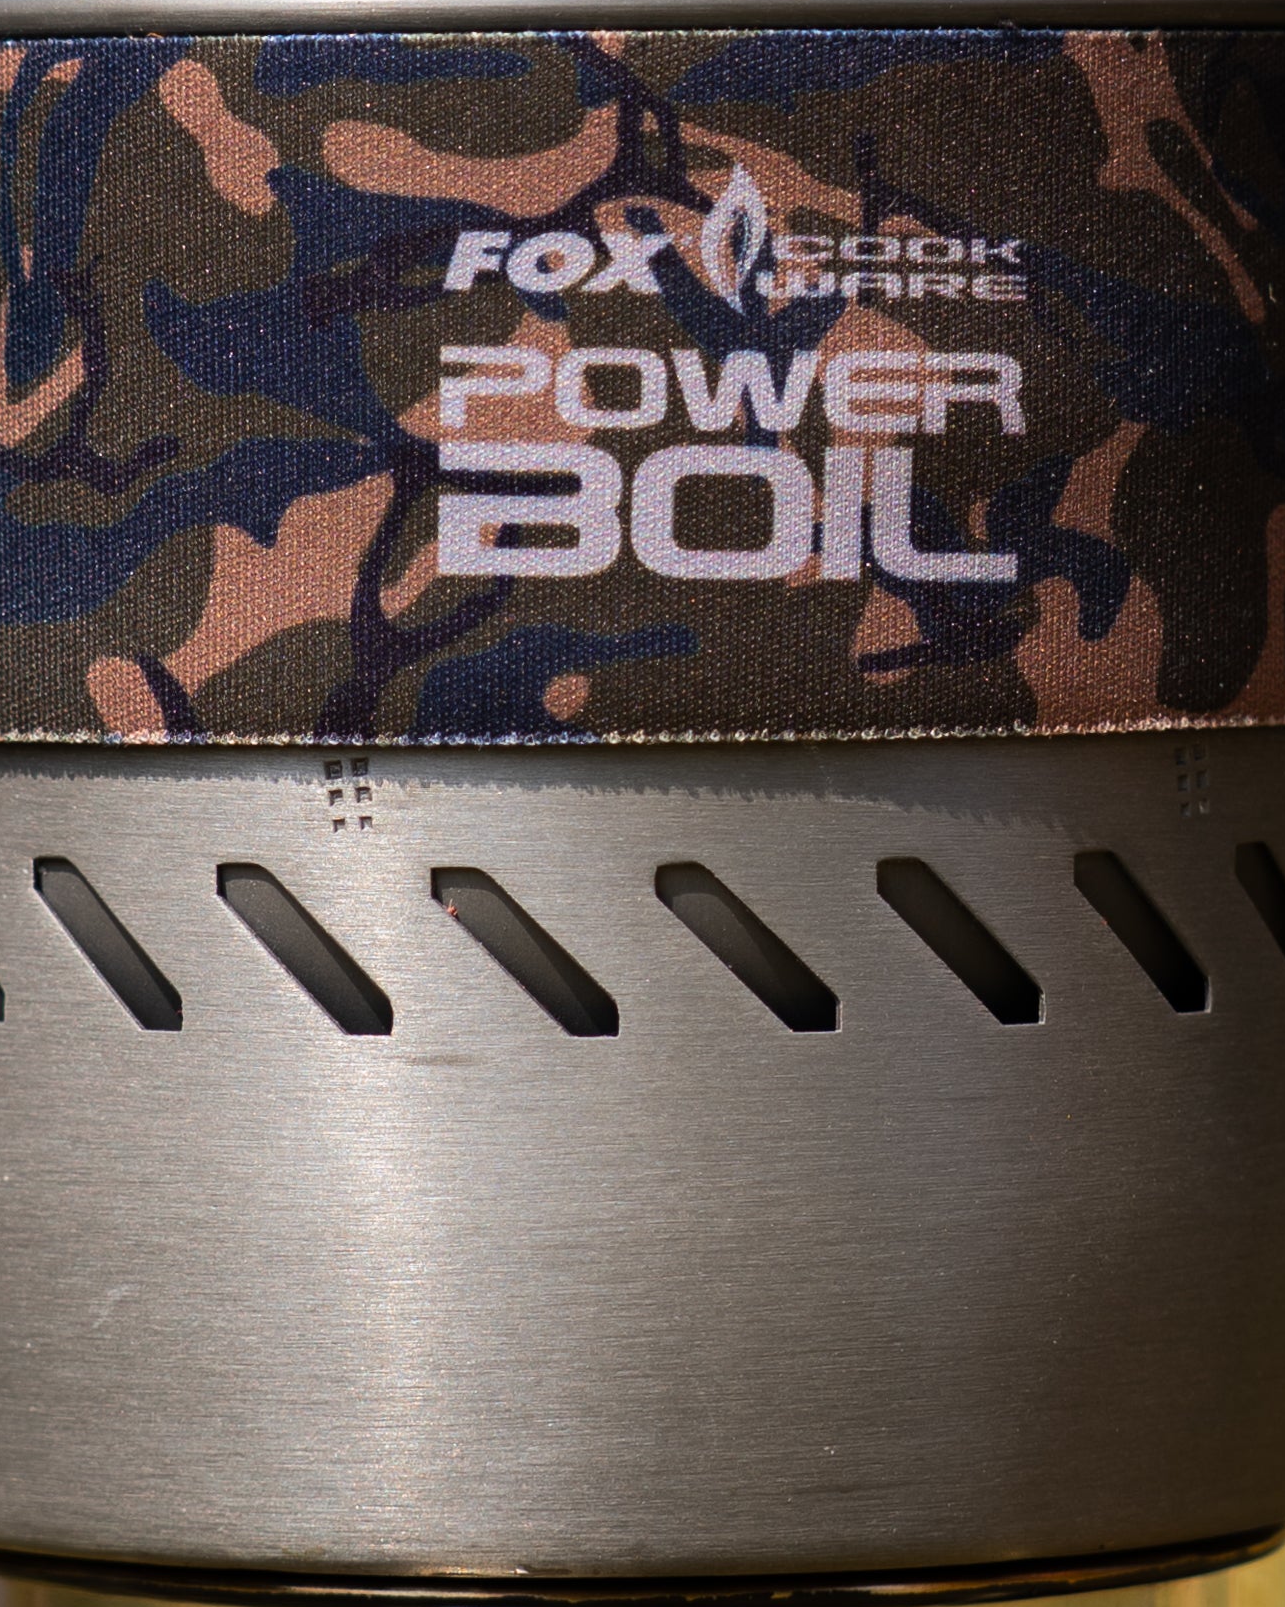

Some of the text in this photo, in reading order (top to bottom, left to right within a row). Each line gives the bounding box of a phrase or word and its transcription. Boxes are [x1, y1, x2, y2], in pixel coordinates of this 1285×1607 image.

[444, 231, 675, 293] FOX
[777, 235, 1023, 264] COOK
[756, 271, 1028, 301] WARE
[439, 345, 1026, 435] POWER
[438, 441, 1018, 581] BOIL
